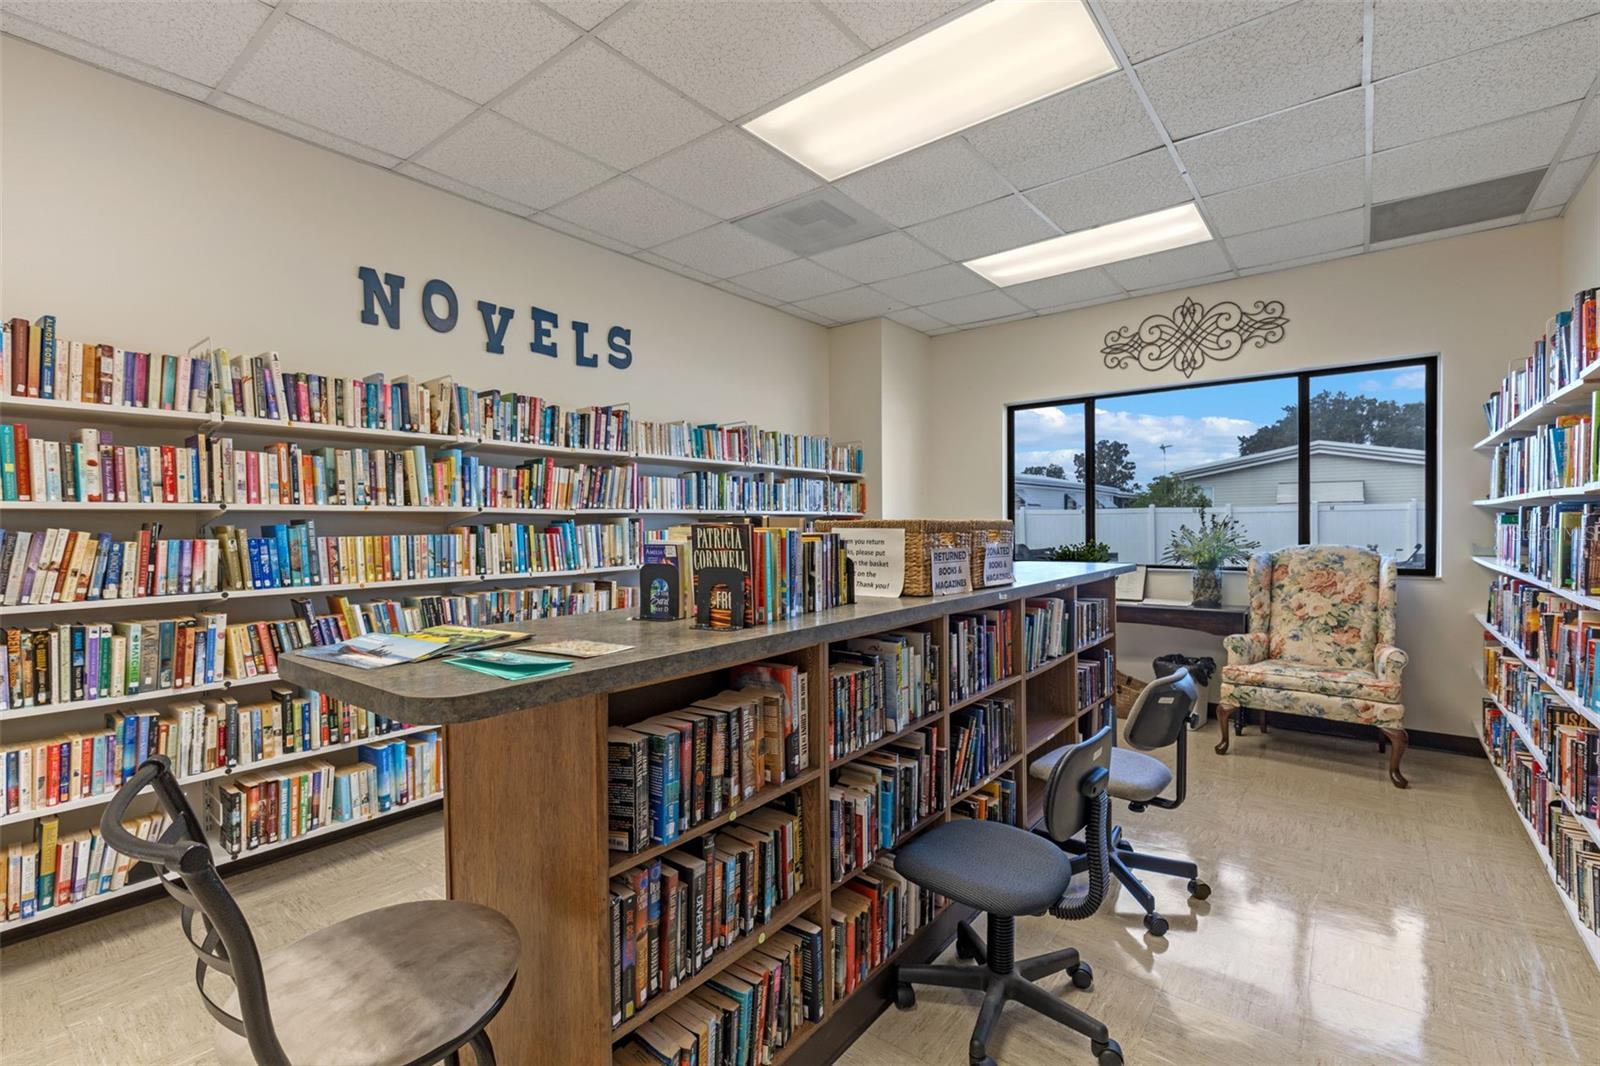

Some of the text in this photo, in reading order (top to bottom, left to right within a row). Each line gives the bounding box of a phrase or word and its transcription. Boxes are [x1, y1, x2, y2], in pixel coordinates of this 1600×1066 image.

[358, 266, 633, 370] NOVELS
[45, 317, 53, 345] ALMOST
[44, 347, 52, 368] GONE
[697, 527, 742, 549] PATRICIA
[693, 550, 748, 572] CORNWELL
[856, 549, 874, 557] please
[933, 550, 967, 562] RETURNED
[869, 560, 889, 568] basket
[939, 566, 957, 576] BOOKS
[856, 580, 874, 588] Thank
[935, 578, 967, 590] MAGAZINES
[131, 643, 140, 683] MATCHED
[696, 894, 704, 956] DIVERGEN
